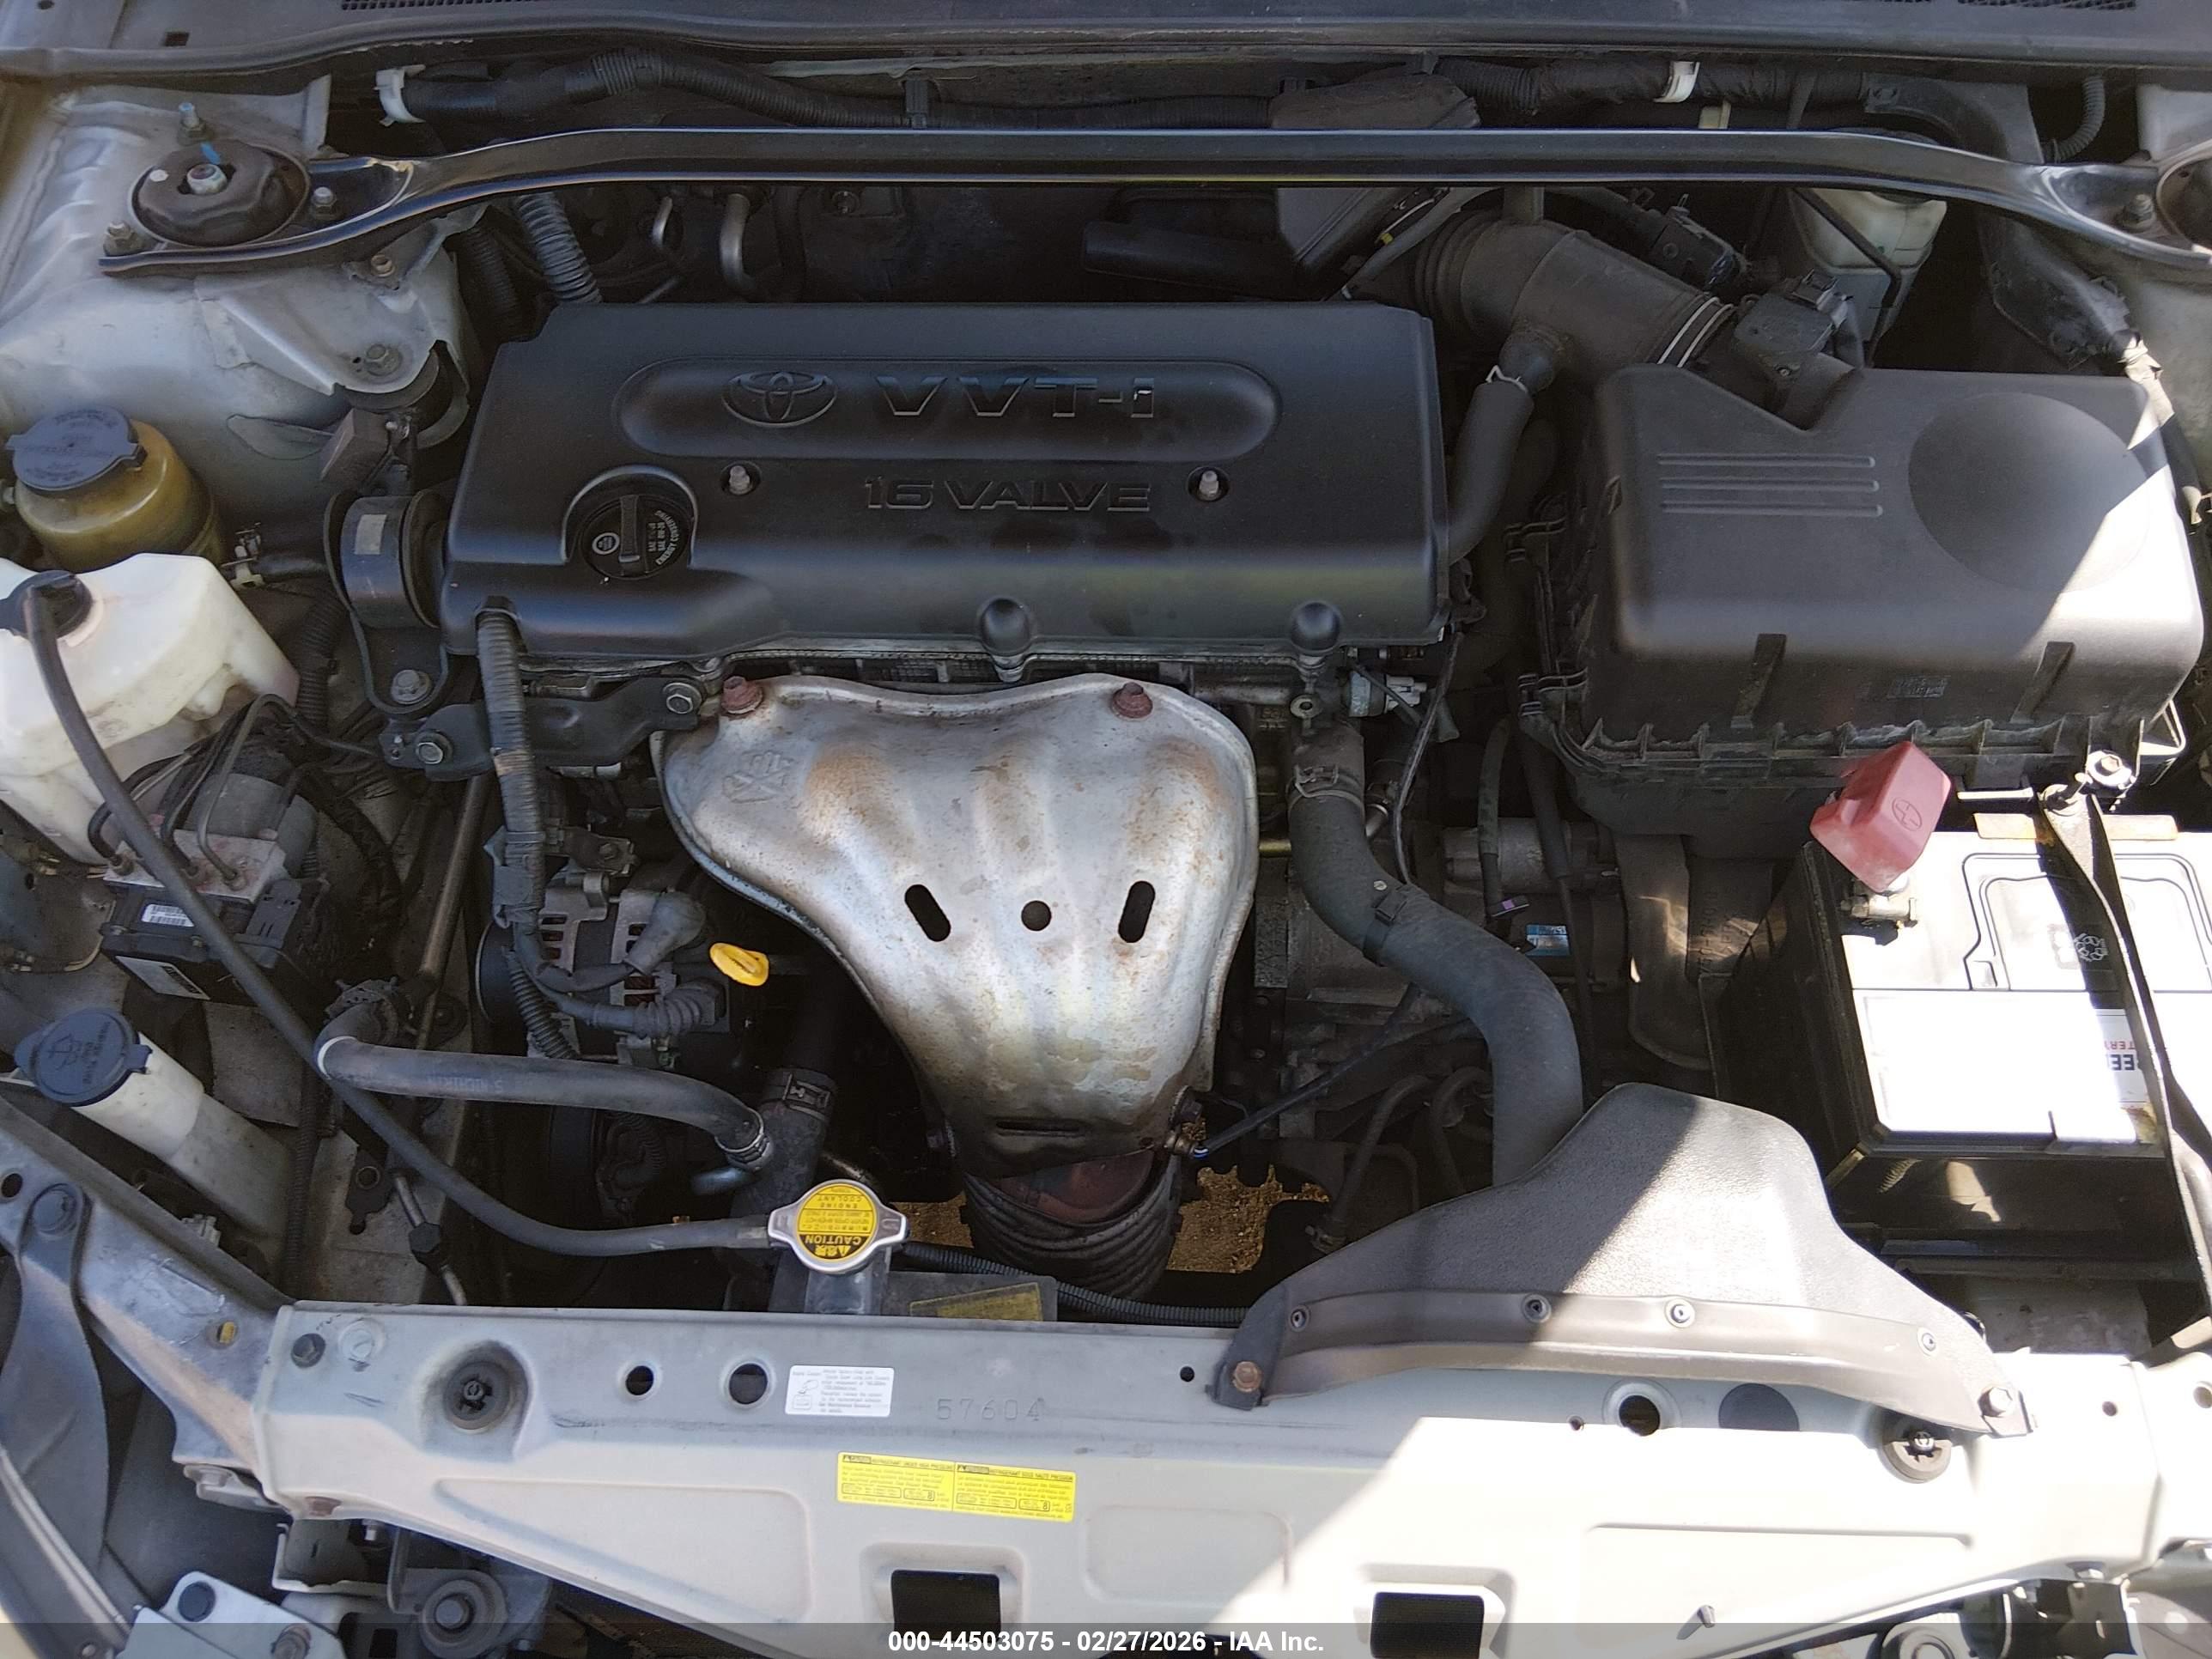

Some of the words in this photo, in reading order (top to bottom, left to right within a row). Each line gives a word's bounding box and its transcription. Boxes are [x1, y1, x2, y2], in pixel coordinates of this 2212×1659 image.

[866, 479, 933, 508] 16
[945, 480, 1151, 512] VALVE
[805, 1235, 862, 1246] CAUTION
[936, 1398, 1045, 1421] 57604
